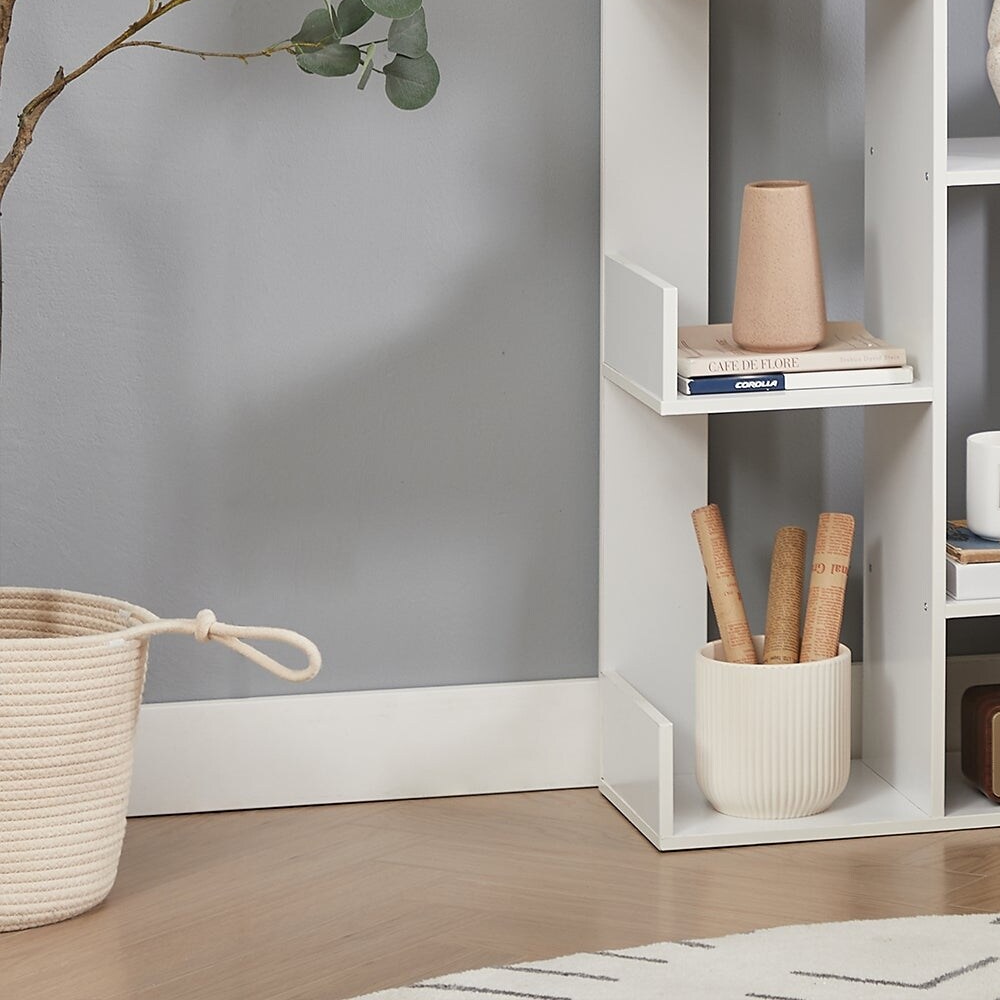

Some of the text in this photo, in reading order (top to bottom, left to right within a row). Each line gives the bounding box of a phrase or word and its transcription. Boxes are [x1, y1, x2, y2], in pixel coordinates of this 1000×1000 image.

[742, 358, 760, 371] DE
[761, 357, 800, 370] FLORE
[735, 379, 778, 390] COROLLA
